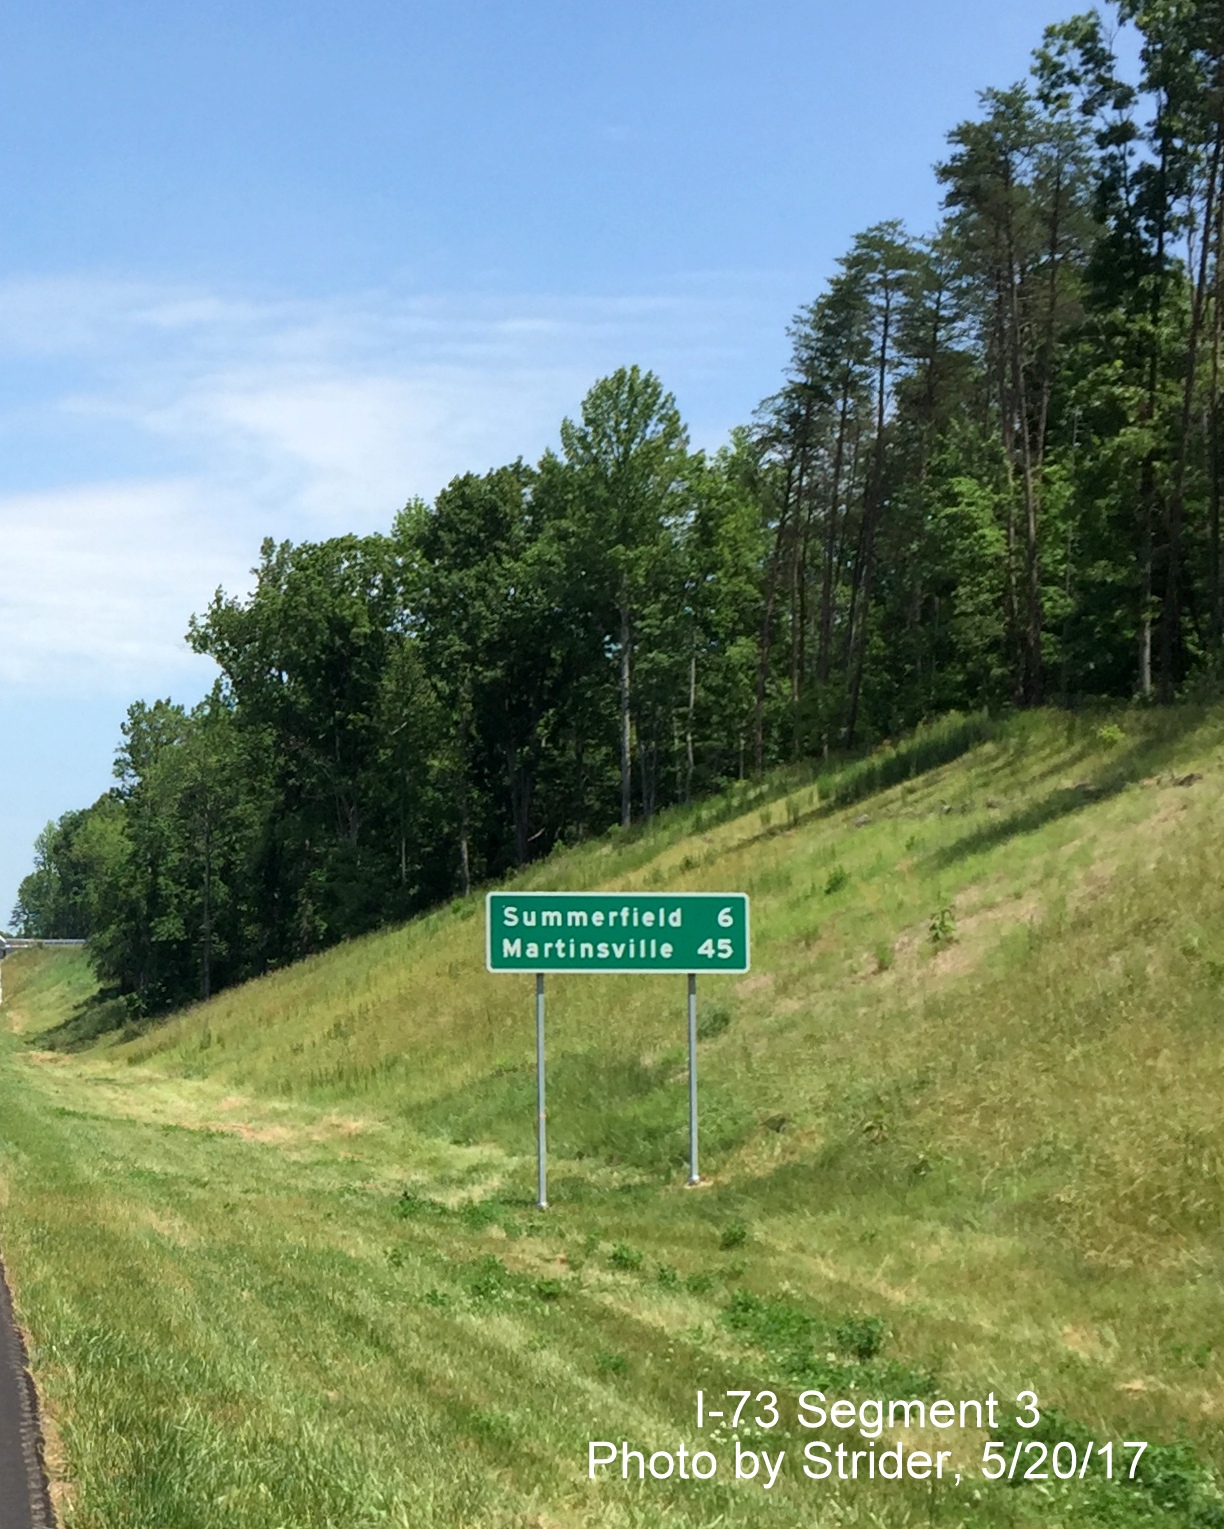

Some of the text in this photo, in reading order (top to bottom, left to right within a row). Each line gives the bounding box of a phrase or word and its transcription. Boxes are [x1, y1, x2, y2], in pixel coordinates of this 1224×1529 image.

[504, 907, 733, 927] Summerfield 6
[503, 939, 733, 958] Martinsville 45
